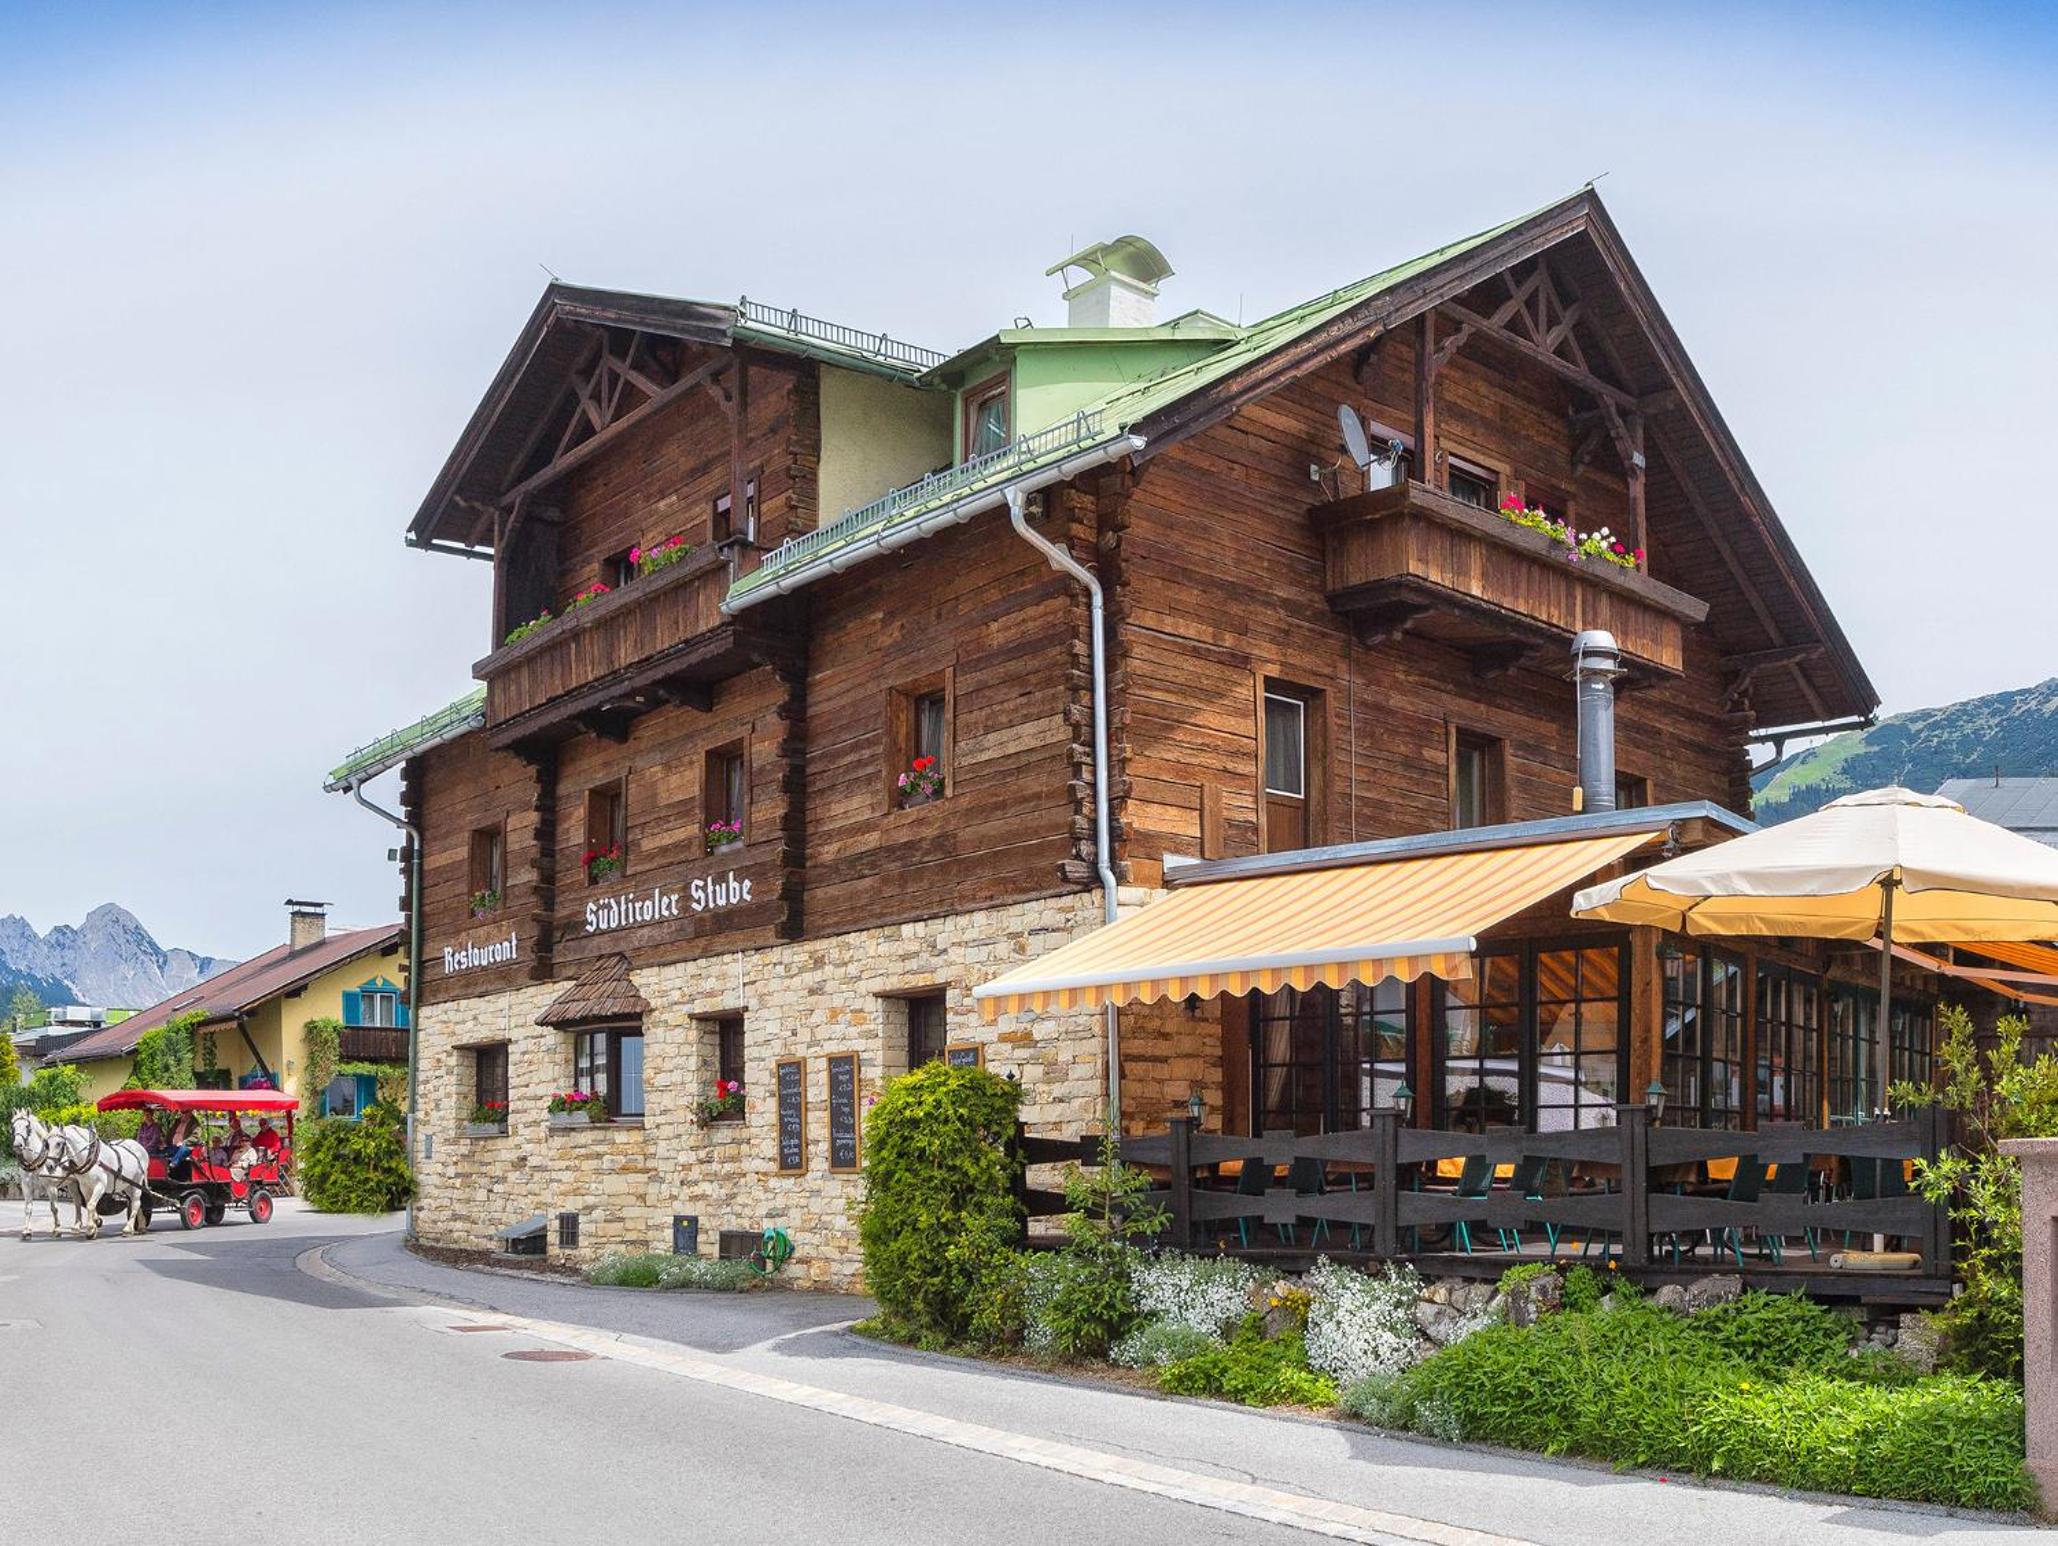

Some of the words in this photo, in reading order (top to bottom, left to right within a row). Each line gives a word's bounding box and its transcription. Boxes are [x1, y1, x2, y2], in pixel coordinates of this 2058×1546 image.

[585, 887, 679, 933] Südtiroler
[690, 870, 753, 912] Stube
[444, 931, 518, 974] Restaurant
